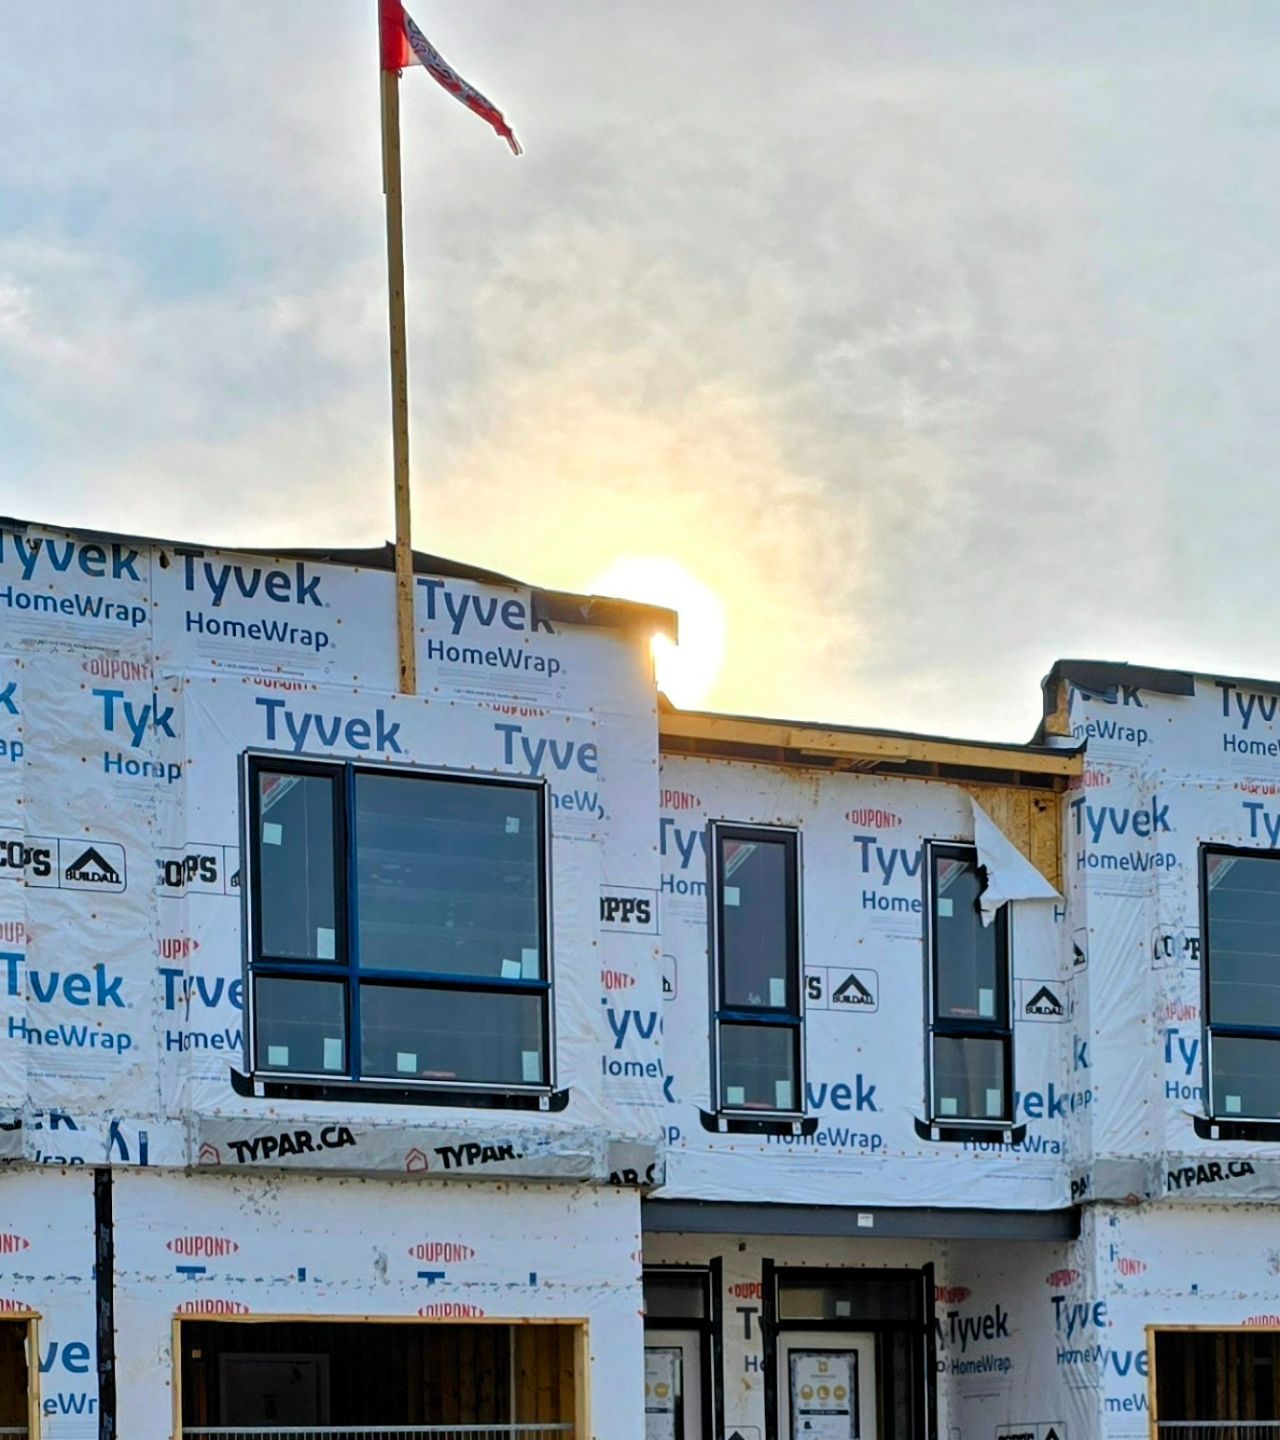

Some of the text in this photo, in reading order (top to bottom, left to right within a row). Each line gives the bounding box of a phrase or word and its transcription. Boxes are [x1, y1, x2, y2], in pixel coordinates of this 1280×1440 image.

[174, 548, 324, 607] Tyvek
[418, 578, 555, 635] Tyvek
[187, 611, 329, 651] HomeWrap
[90, 658, 148, 681] DUPONT
[428, 641, 560, 677] HomeWrap
[255, 697, 403, 753] Tyvek
[852, 810, 896, 829] DUPONT
[1070, 797, 1171, 842] Tyvek
[228, 1127, 355, 1163] TYPAR.CA
[175, 1237, 231, 1257] DUPONT
[416, 1244, 468, 1263] DUPONT
[947, 1305, 1009, 1351] Tyvek
[952, 1356, 1011, 1375] HomeWrap
